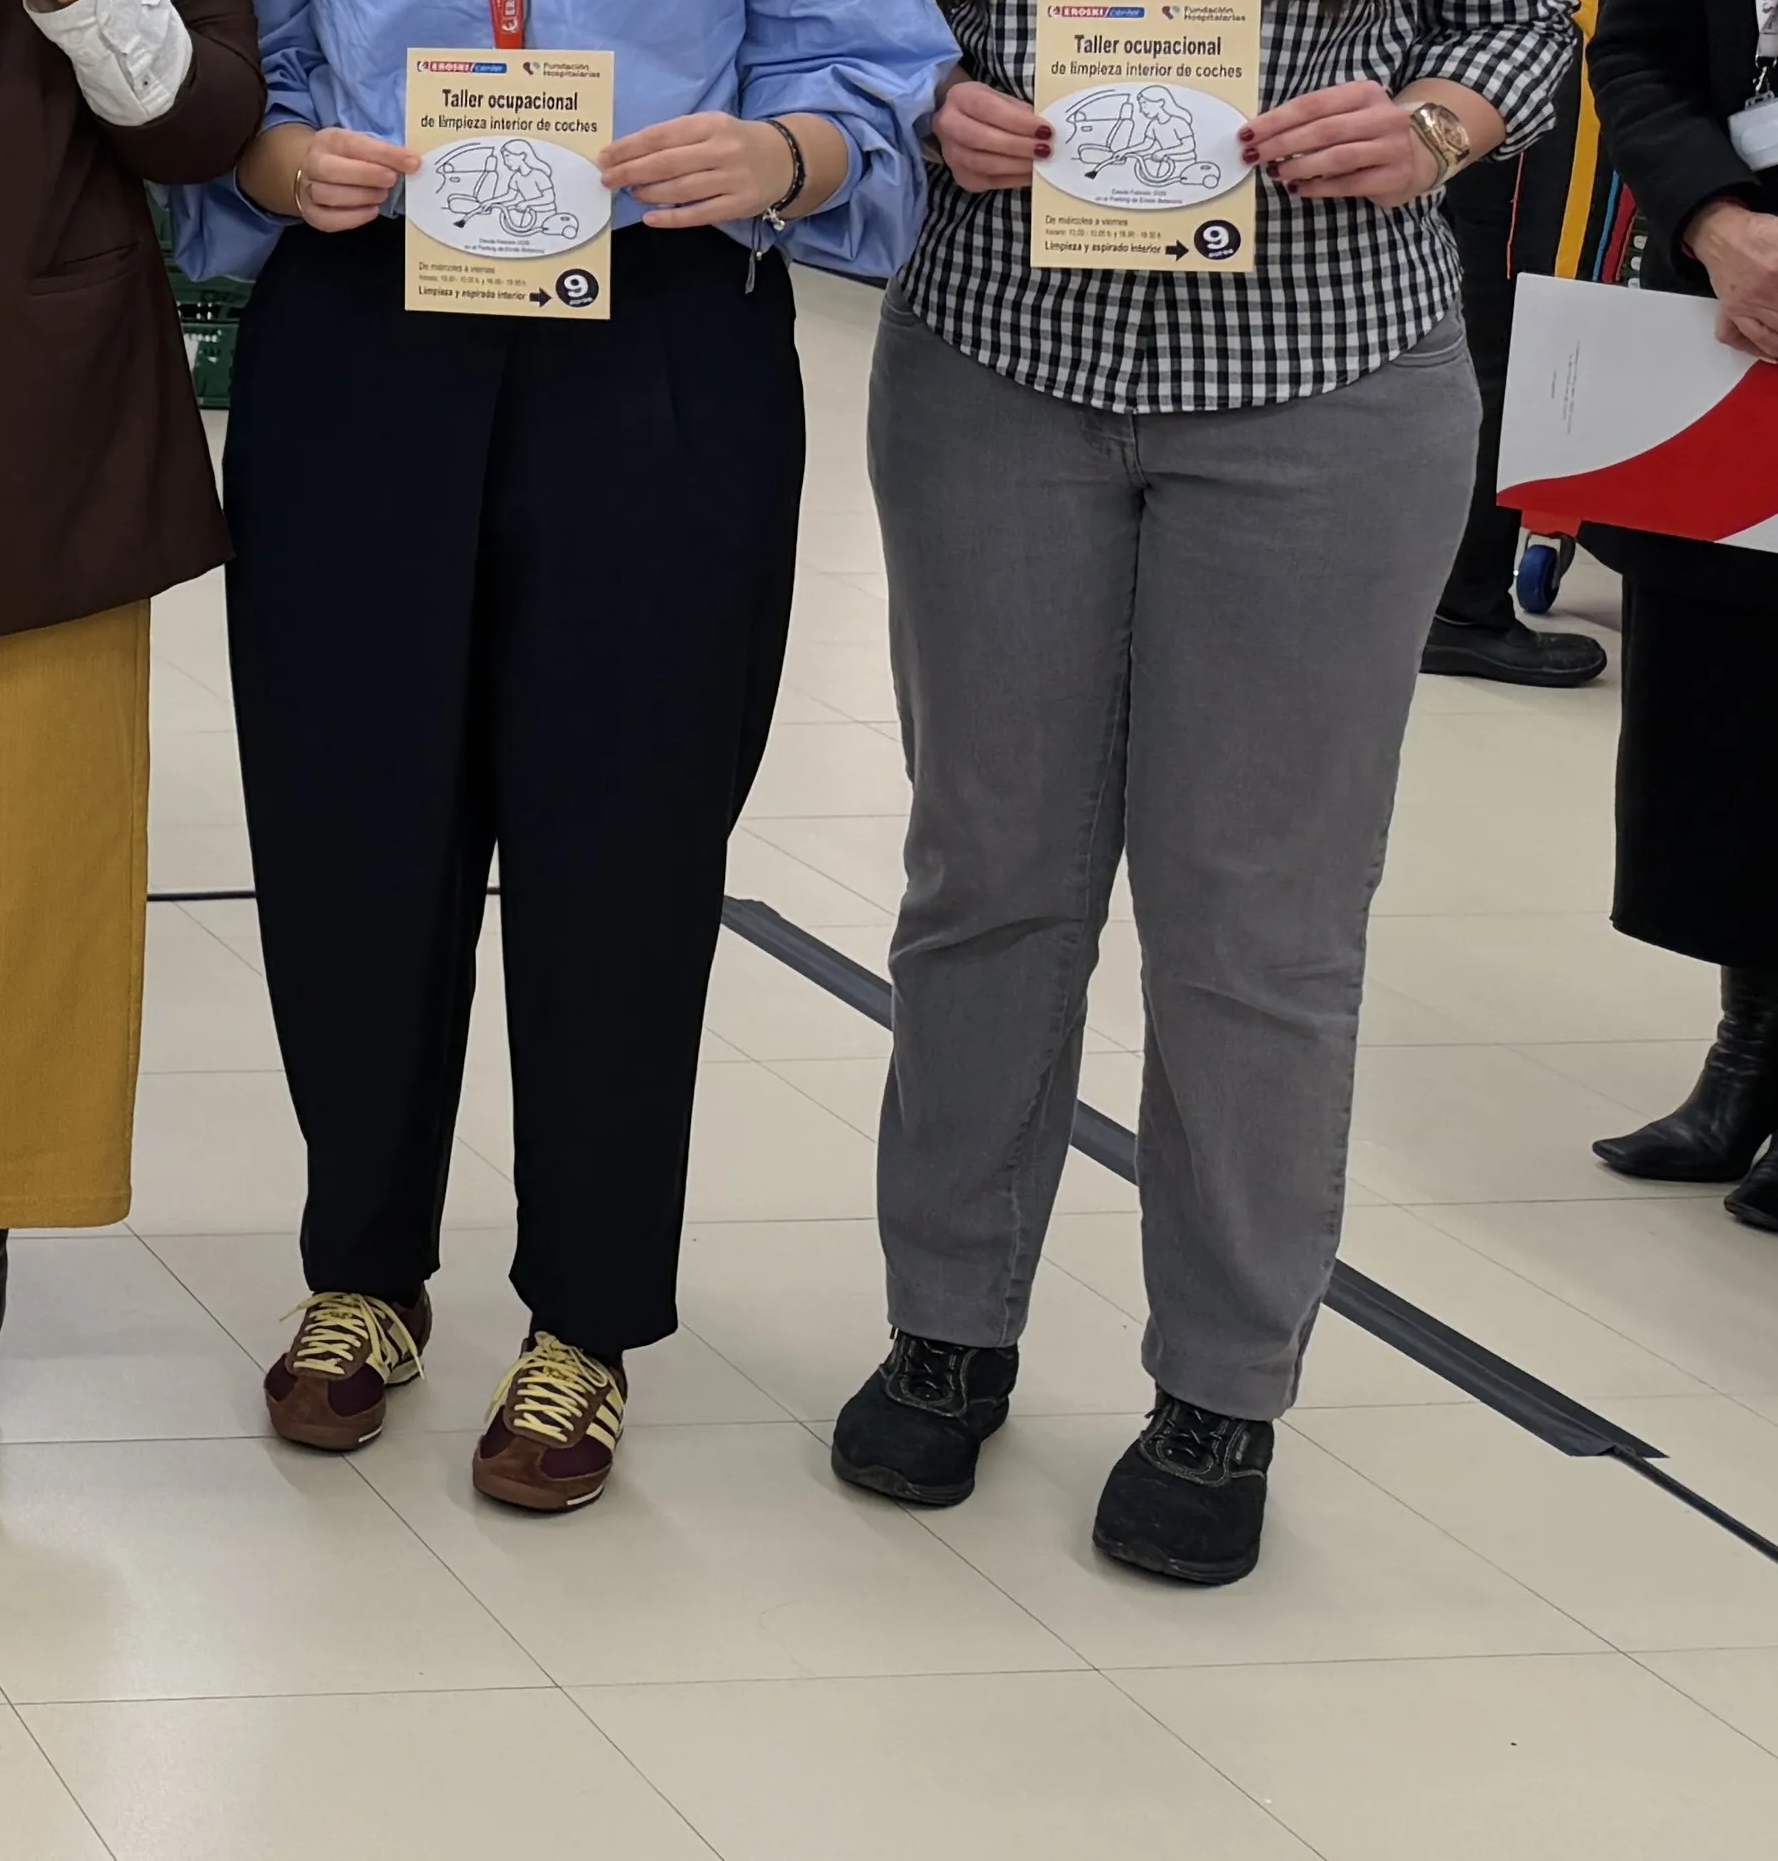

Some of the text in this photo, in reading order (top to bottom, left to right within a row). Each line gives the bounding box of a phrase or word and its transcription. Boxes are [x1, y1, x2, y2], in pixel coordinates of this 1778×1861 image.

[1063, 7, 1104, 15] EROSKI
[1073, 34, 1220, 59] Taller ocupacional
[1050, 61, 1242, 78] de limpieza interior de coches
[441, 89, 577, 114] Taller ocupacional
[421, 114, 597, 132] de limpieza interior de coches
[1201, 225, 1229, 250] 9
[563, 274, 588, 298] 9
